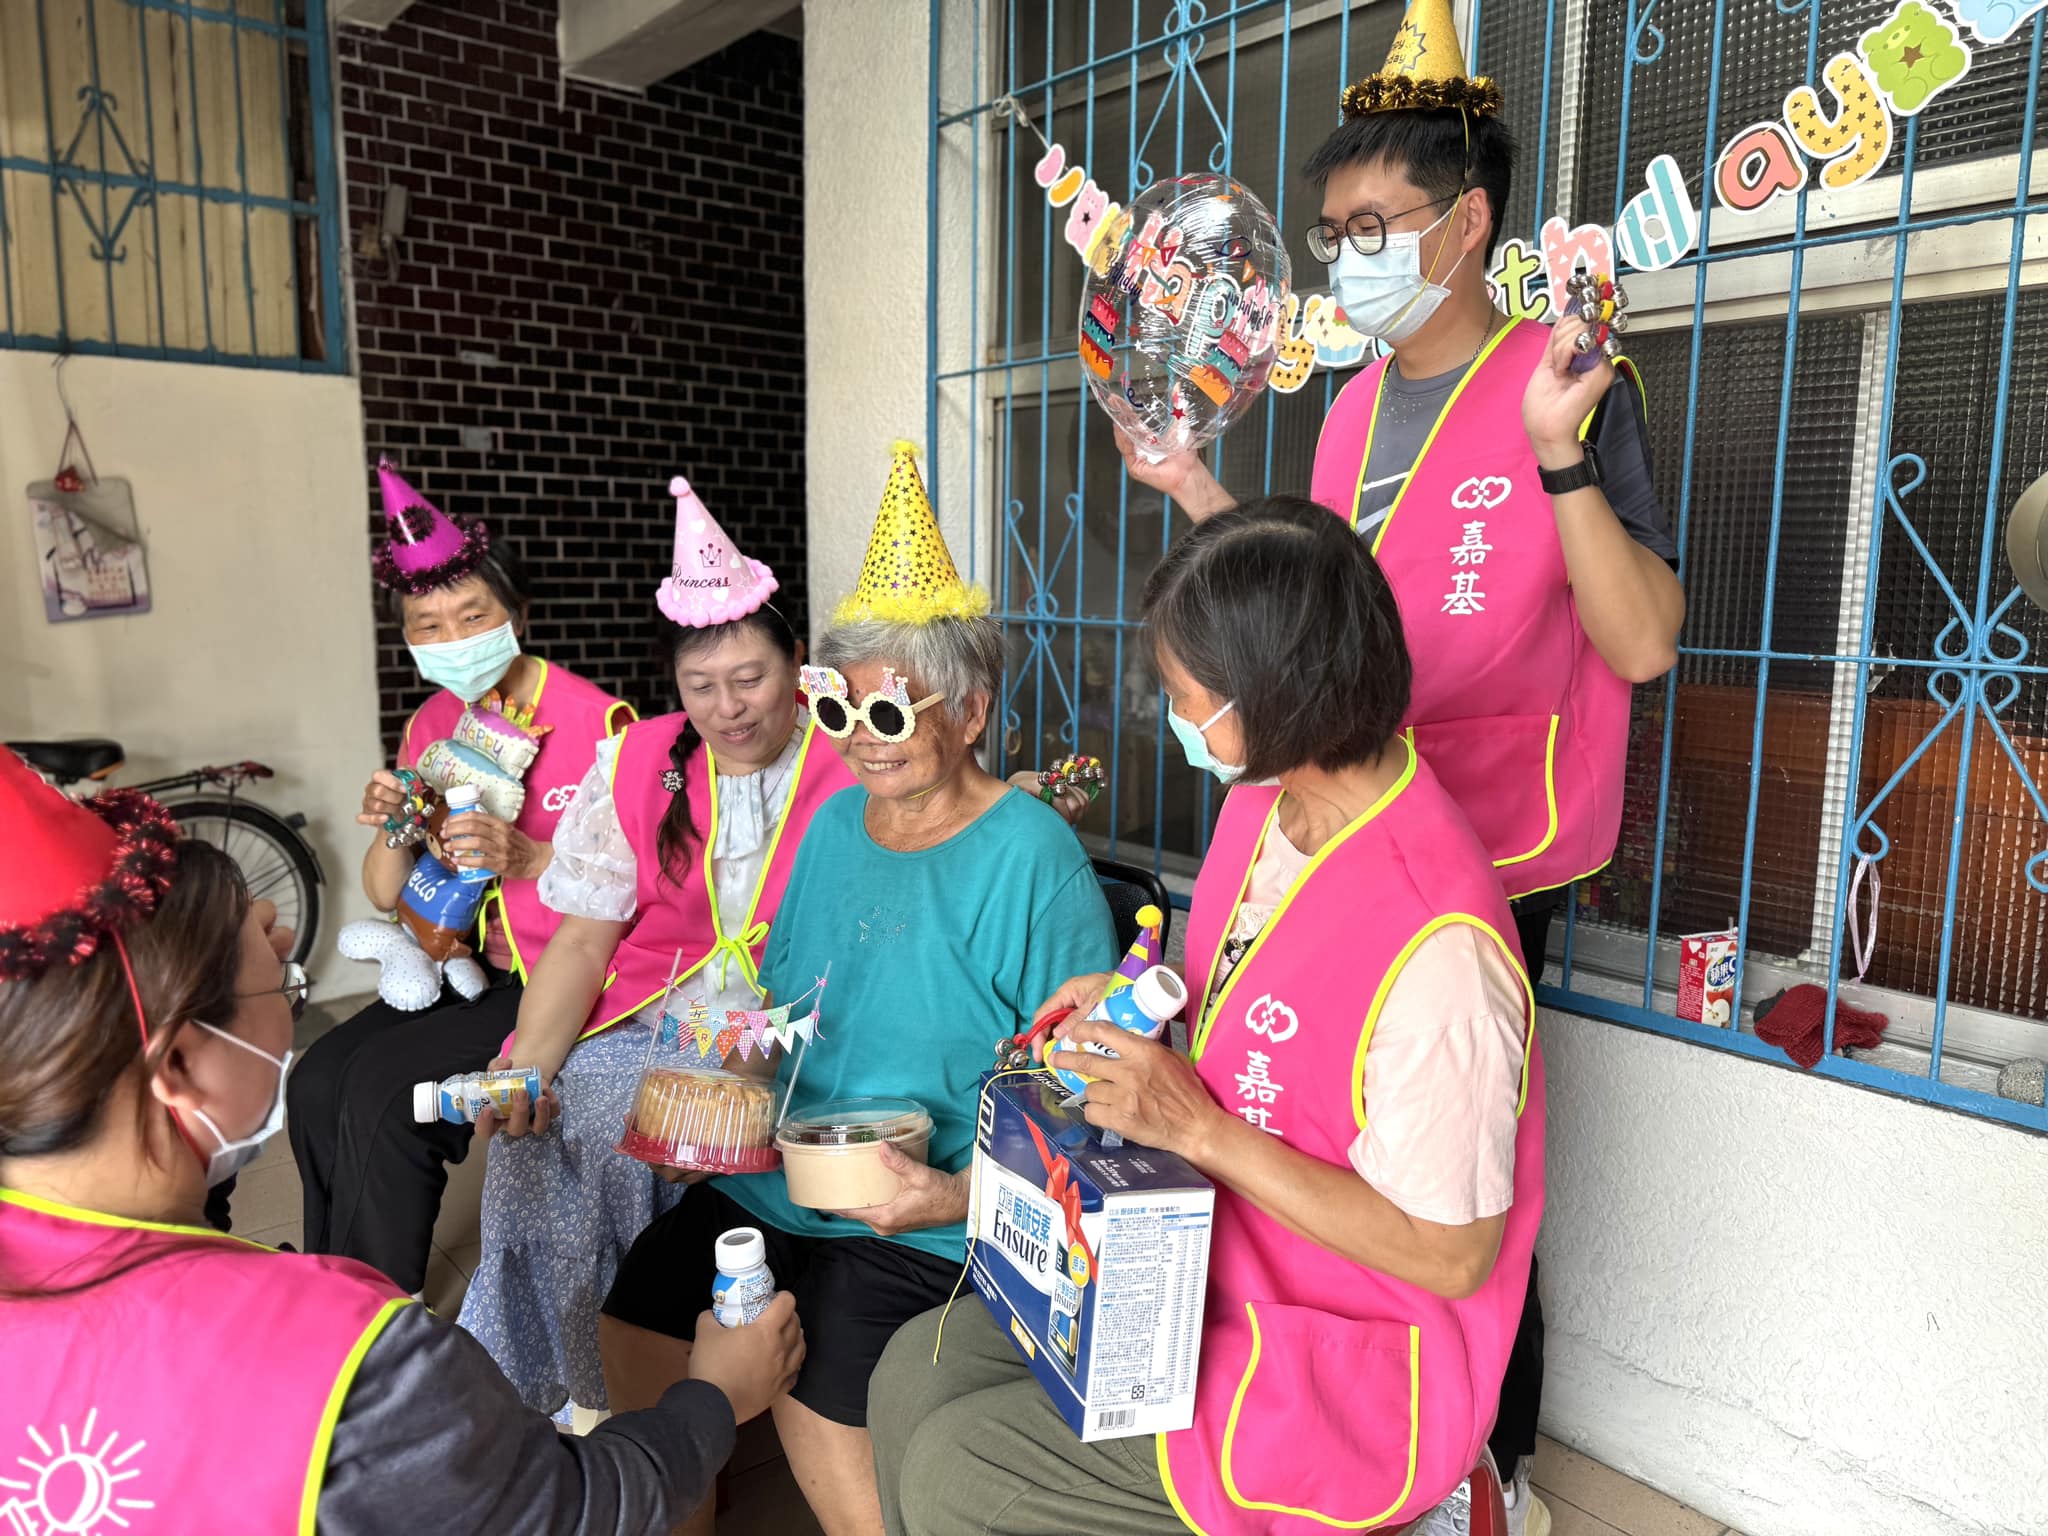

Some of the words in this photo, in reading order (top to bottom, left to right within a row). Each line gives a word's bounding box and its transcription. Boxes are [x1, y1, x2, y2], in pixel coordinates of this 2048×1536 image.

[1490, 52, 1891, 320] thday
[672, 563, 731, 588] Princess
[1440, 520, 1494, 615] 嘉基
[461, 717, 504, 761] Happy
[993, 1208, 1048, 1274] Ensure
